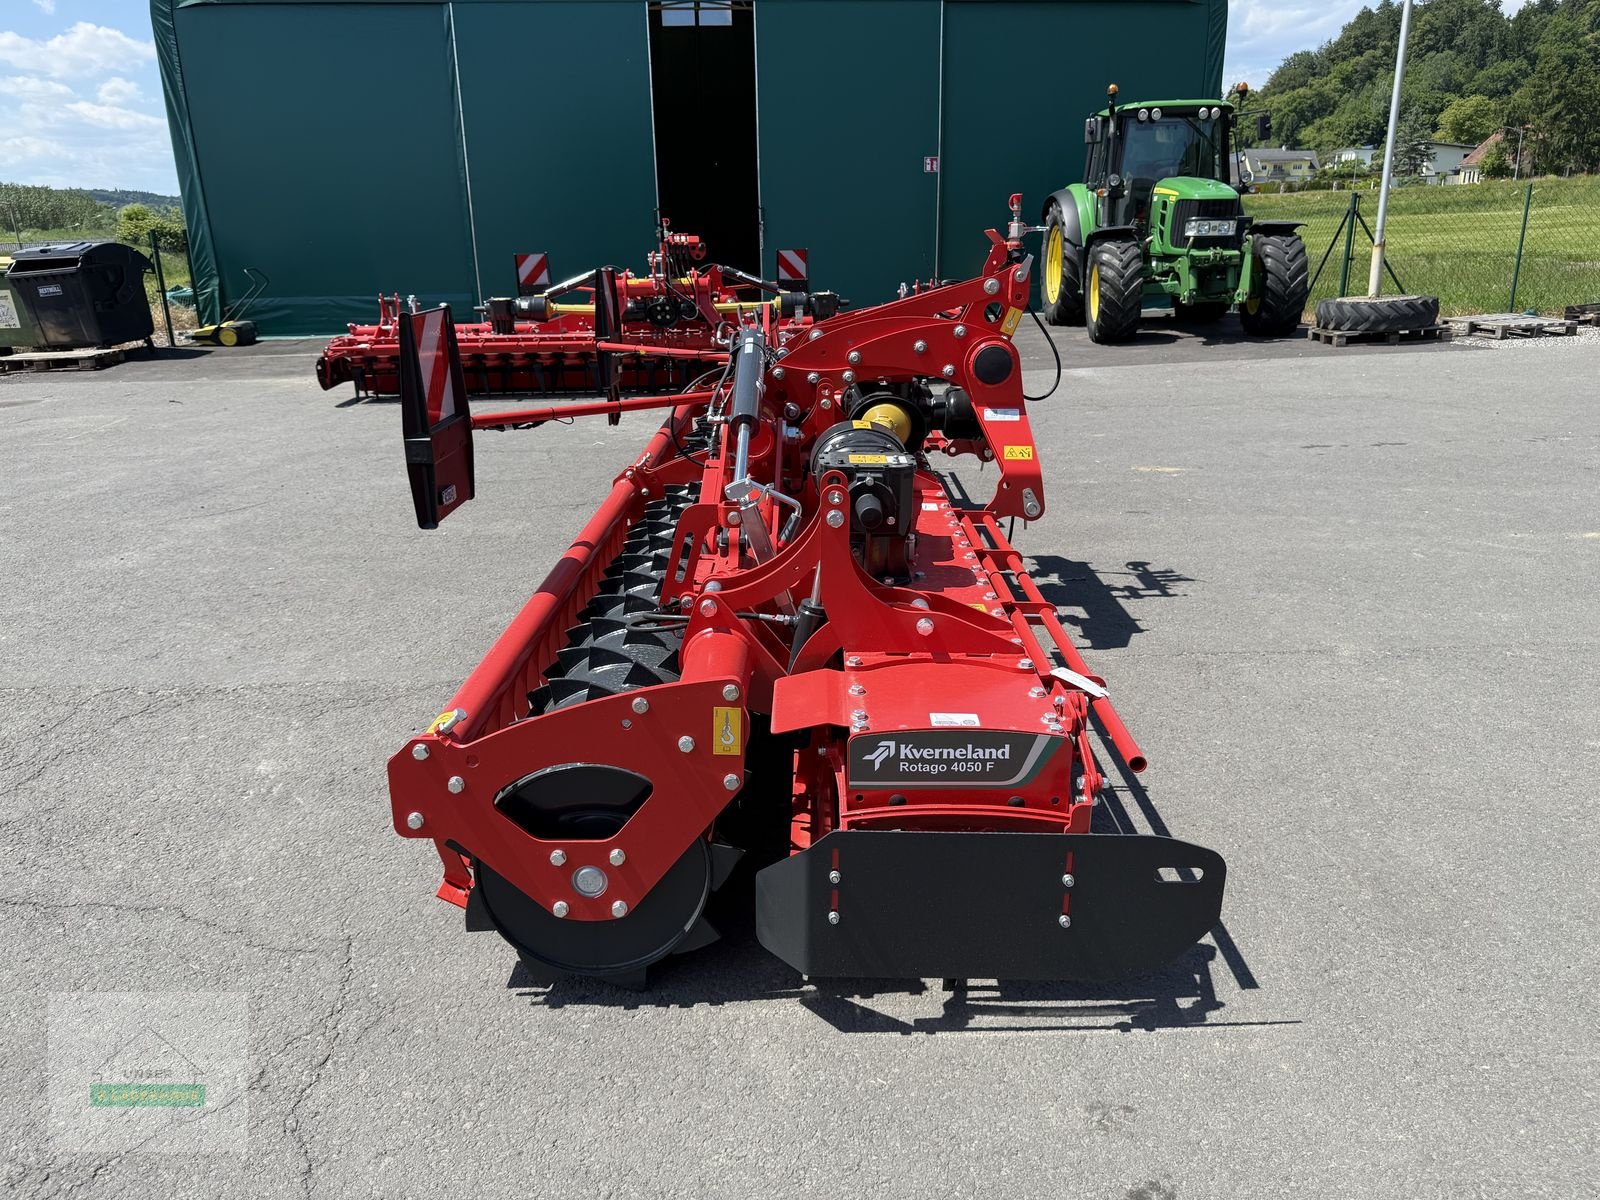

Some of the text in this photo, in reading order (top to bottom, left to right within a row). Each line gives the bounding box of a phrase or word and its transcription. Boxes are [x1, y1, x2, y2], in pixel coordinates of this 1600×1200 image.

[900, 744, 1010, 760] Kverneland
[900, 762, 995, 775] Rotago 4050 F
